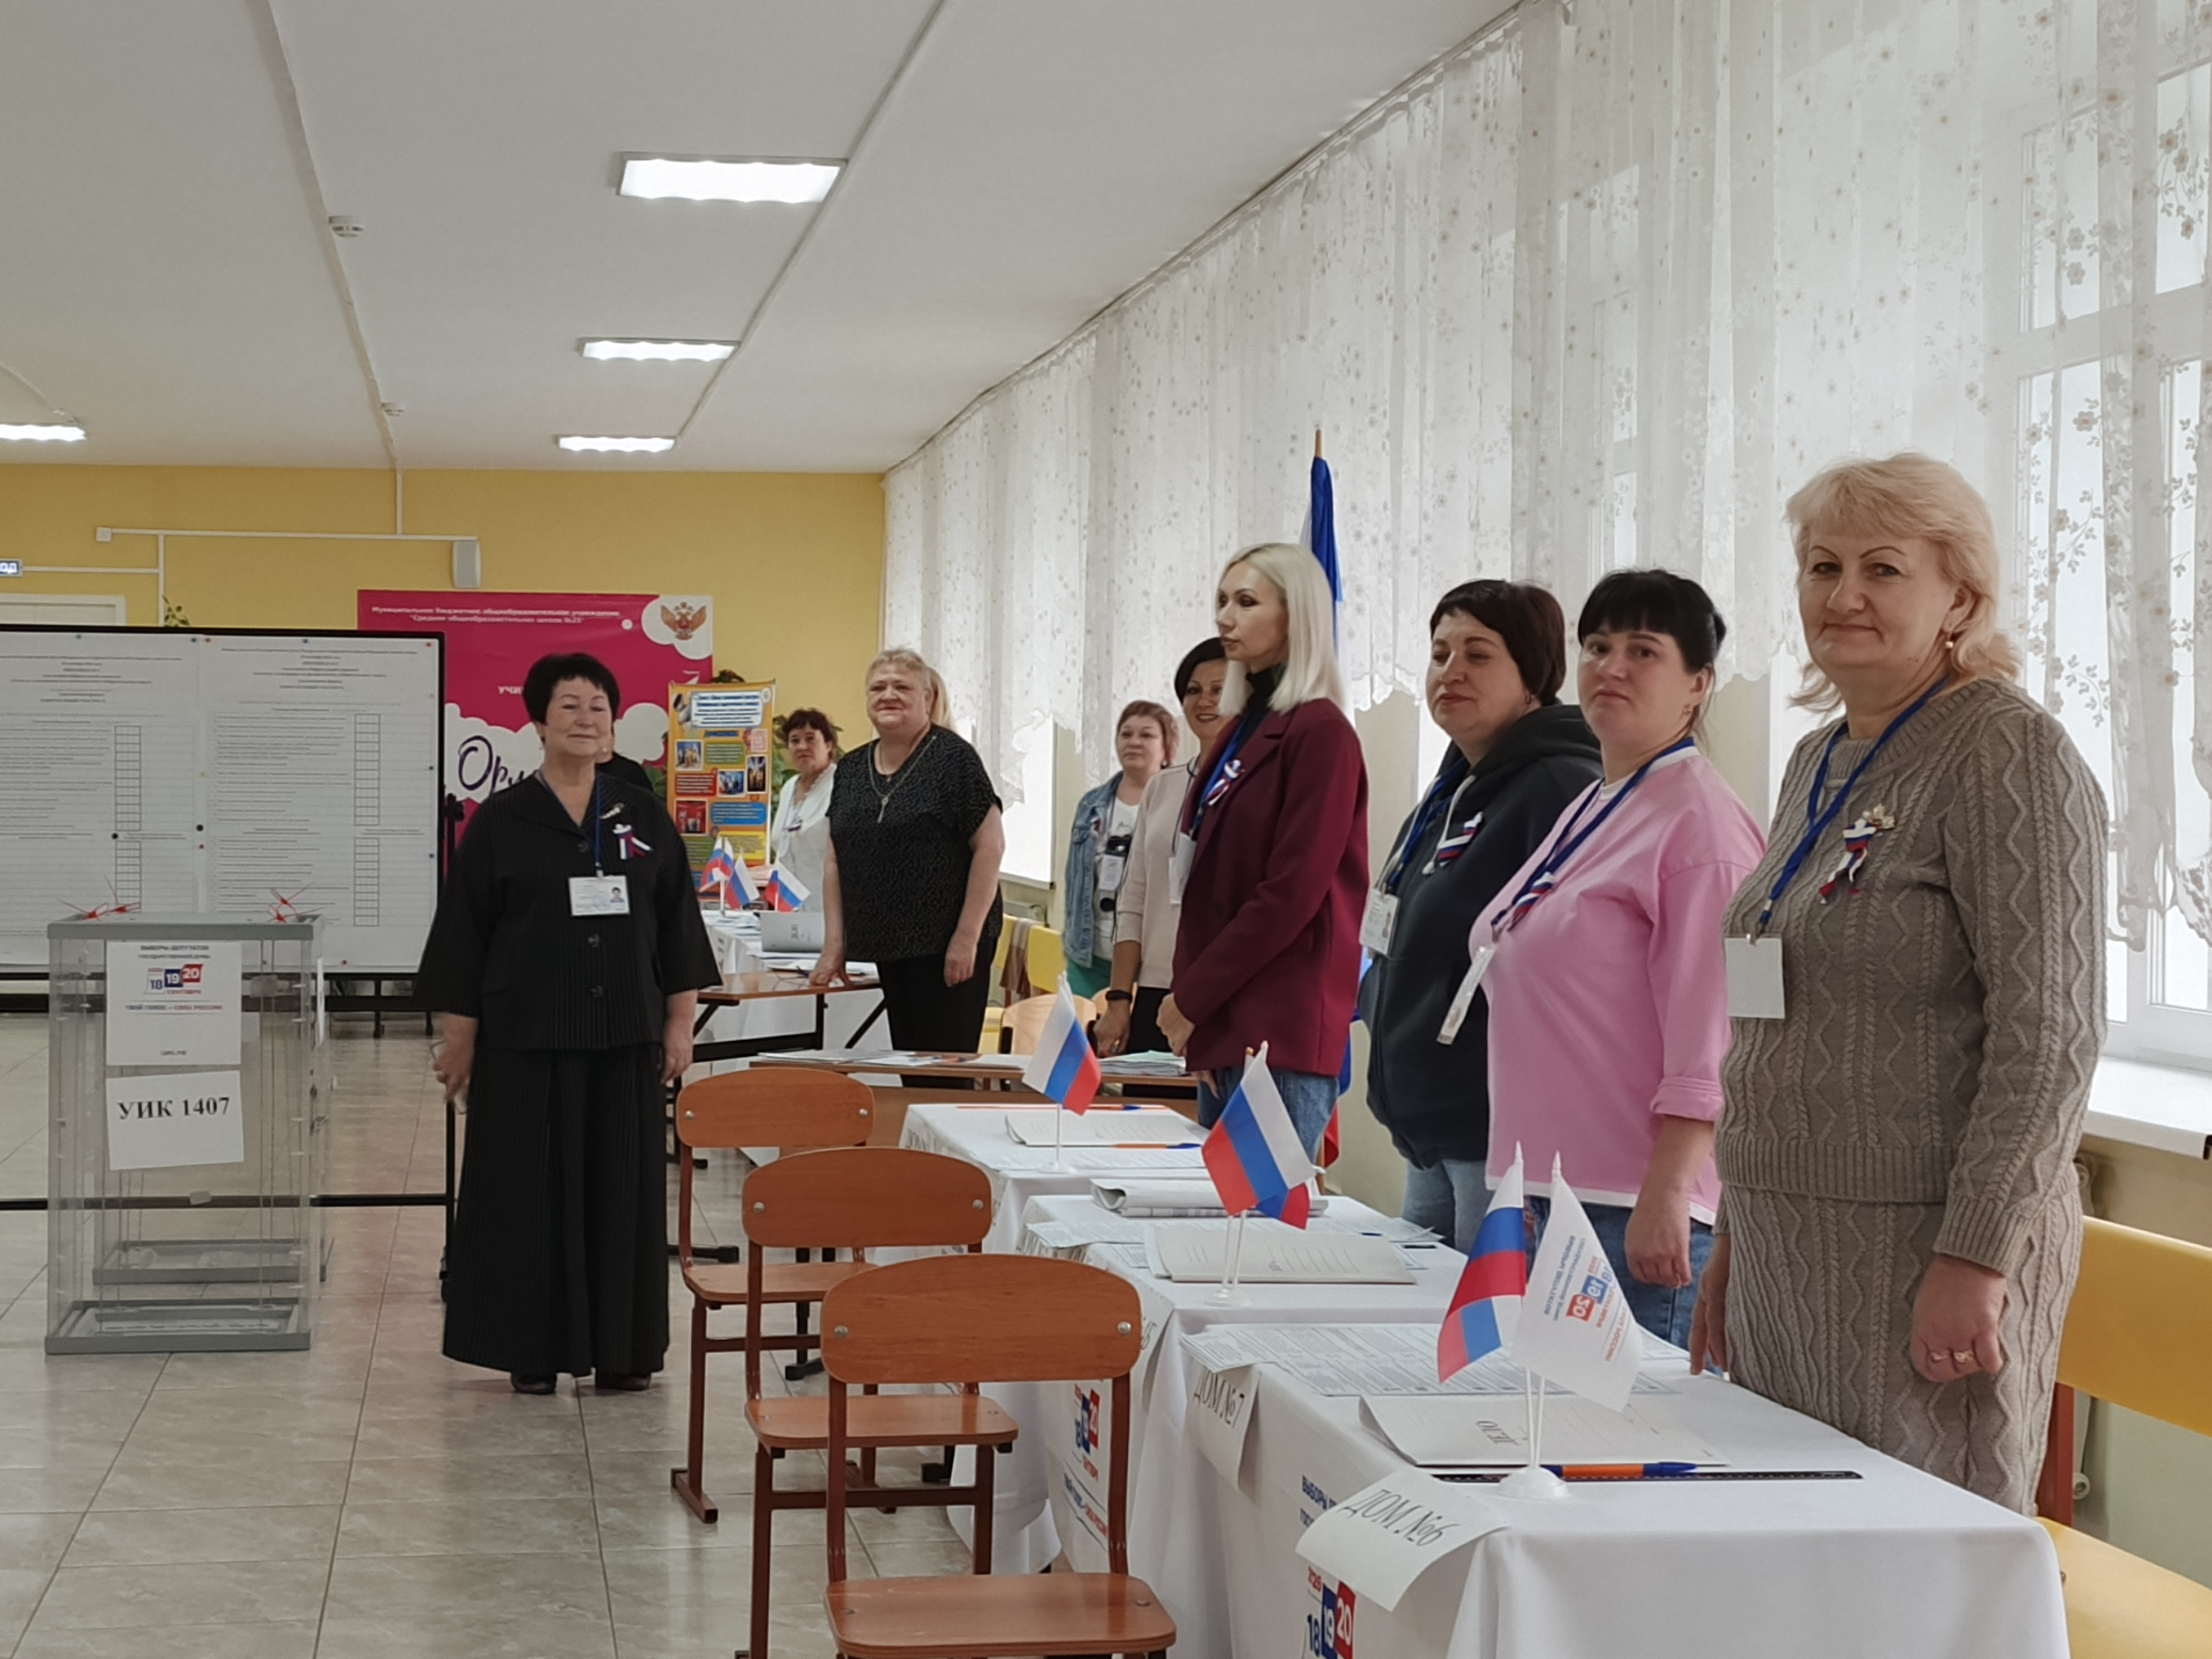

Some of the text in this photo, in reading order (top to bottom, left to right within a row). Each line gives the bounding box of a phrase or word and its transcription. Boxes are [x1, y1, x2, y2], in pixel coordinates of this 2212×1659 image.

[0, 563, 17, 573] ОД
[498, 686, 522, 695] УЧИ
[151, 968, 200, 990] 18 19 20
[117, 1096, 230, 1120] УИК 1407
[1336, 1488, 1423, 1530] ДОМ
[1393, 1510, 1461, 1547] №6
[1307, 1597, 1352, 1657] 18 19 20
